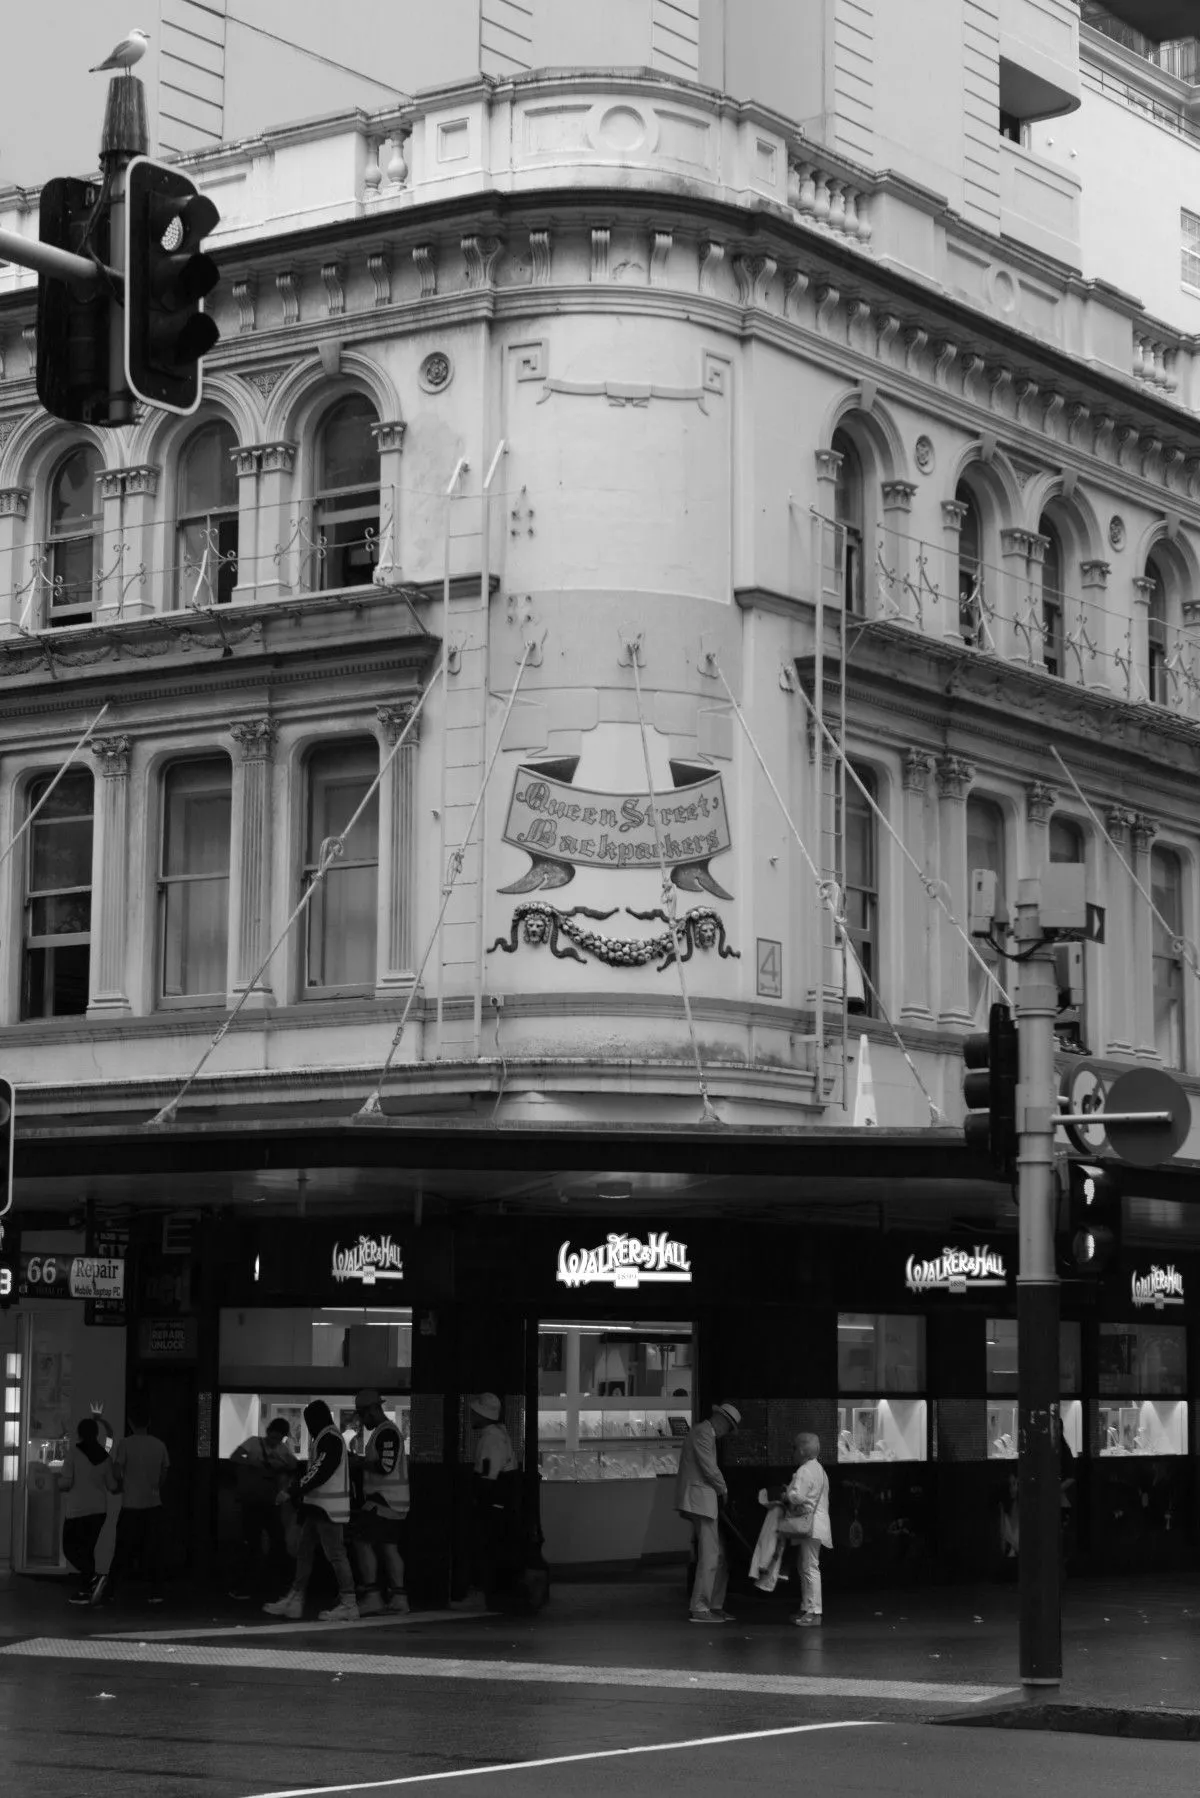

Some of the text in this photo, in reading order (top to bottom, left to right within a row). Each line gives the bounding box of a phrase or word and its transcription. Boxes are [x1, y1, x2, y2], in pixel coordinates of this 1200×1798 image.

[516, 782, 618, 827] Queen
[517, 818, 720, 867] Backpackers
[760, 945, 779, 982] 4
[27, 1256, 57, 1284] 66
[75, 1259, 119, 1283] Repair
[112, 1286, 121, 1297] PC
